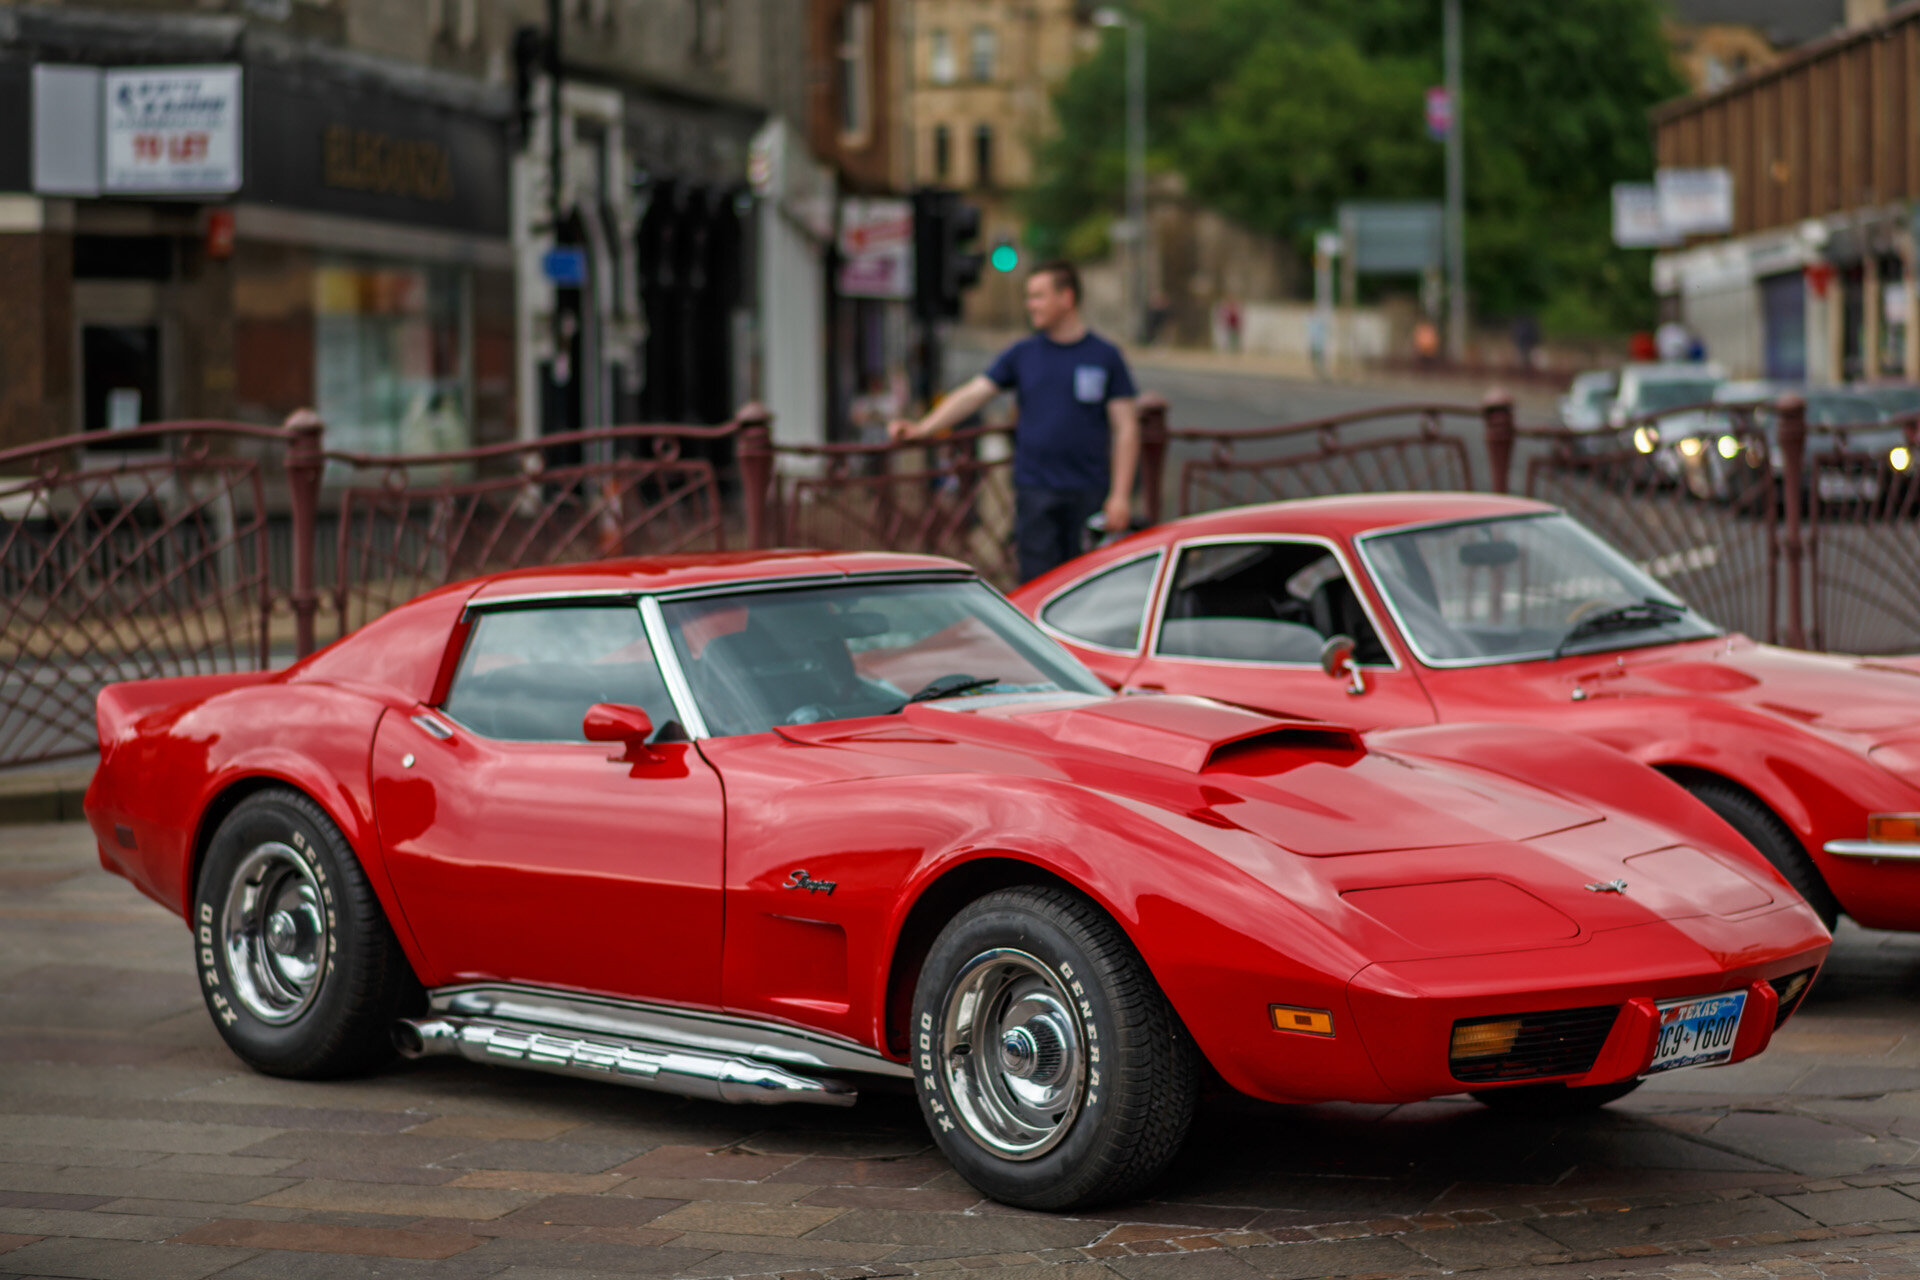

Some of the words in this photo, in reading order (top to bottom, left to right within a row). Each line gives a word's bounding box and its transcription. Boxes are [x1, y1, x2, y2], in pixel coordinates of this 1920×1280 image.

[133, 133, 163, 163] TO
[168, 131, 211, 163] LET
[293, 831, 337, 976] GENERAL
[1678, 1001, 1719, 1021] TEXAS
[1059, 961, 1101, 1107] GENERAL
[1693, 1014, 1736, 1051] Y600
